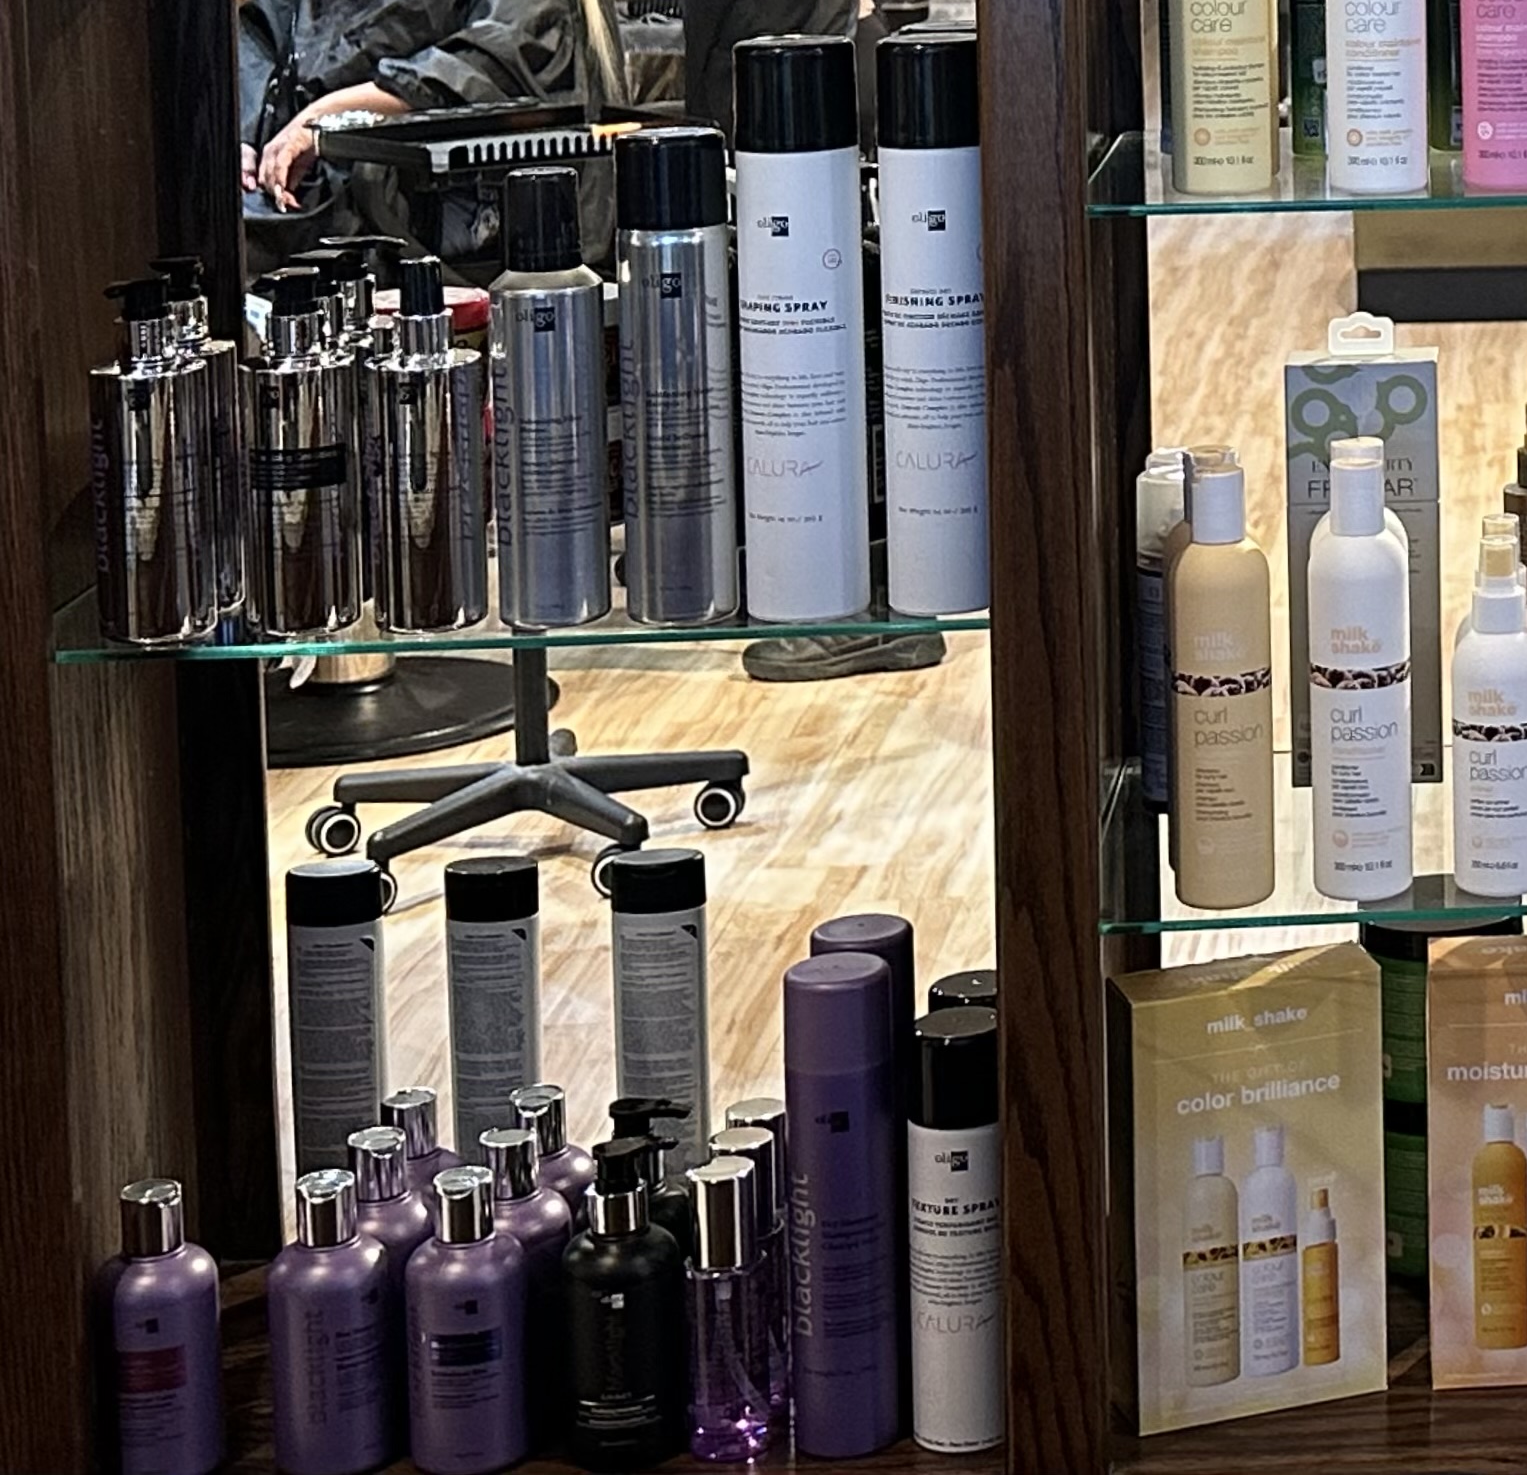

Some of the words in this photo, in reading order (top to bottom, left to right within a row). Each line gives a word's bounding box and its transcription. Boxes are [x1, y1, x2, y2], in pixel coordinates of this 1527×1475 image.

[1190, 0, 1247, 15] colour
[1345, 0, 1400, 15] colour
[1476, 4, 1516, 19] care
[1191, 18, 1232, 32] care
[1346, 18, 1386, 32] care
[785, 300, 828, 312] SPRAY
[1331, 641, 1379, 655] shake
[1195, 706, 1228, 724] curl
[1331, 706, 1362, 723] curl
[1195, 723, 1263, 748] passion
[1331, 723, 1398, 744] passion
[1469, 749, 1497, 765] curl
[1207, 1006, 1307, 1035] milk_shake
[1176, 1093, 1233, 1115] color
[1241, 1074, 1341, 1106] brilliance
